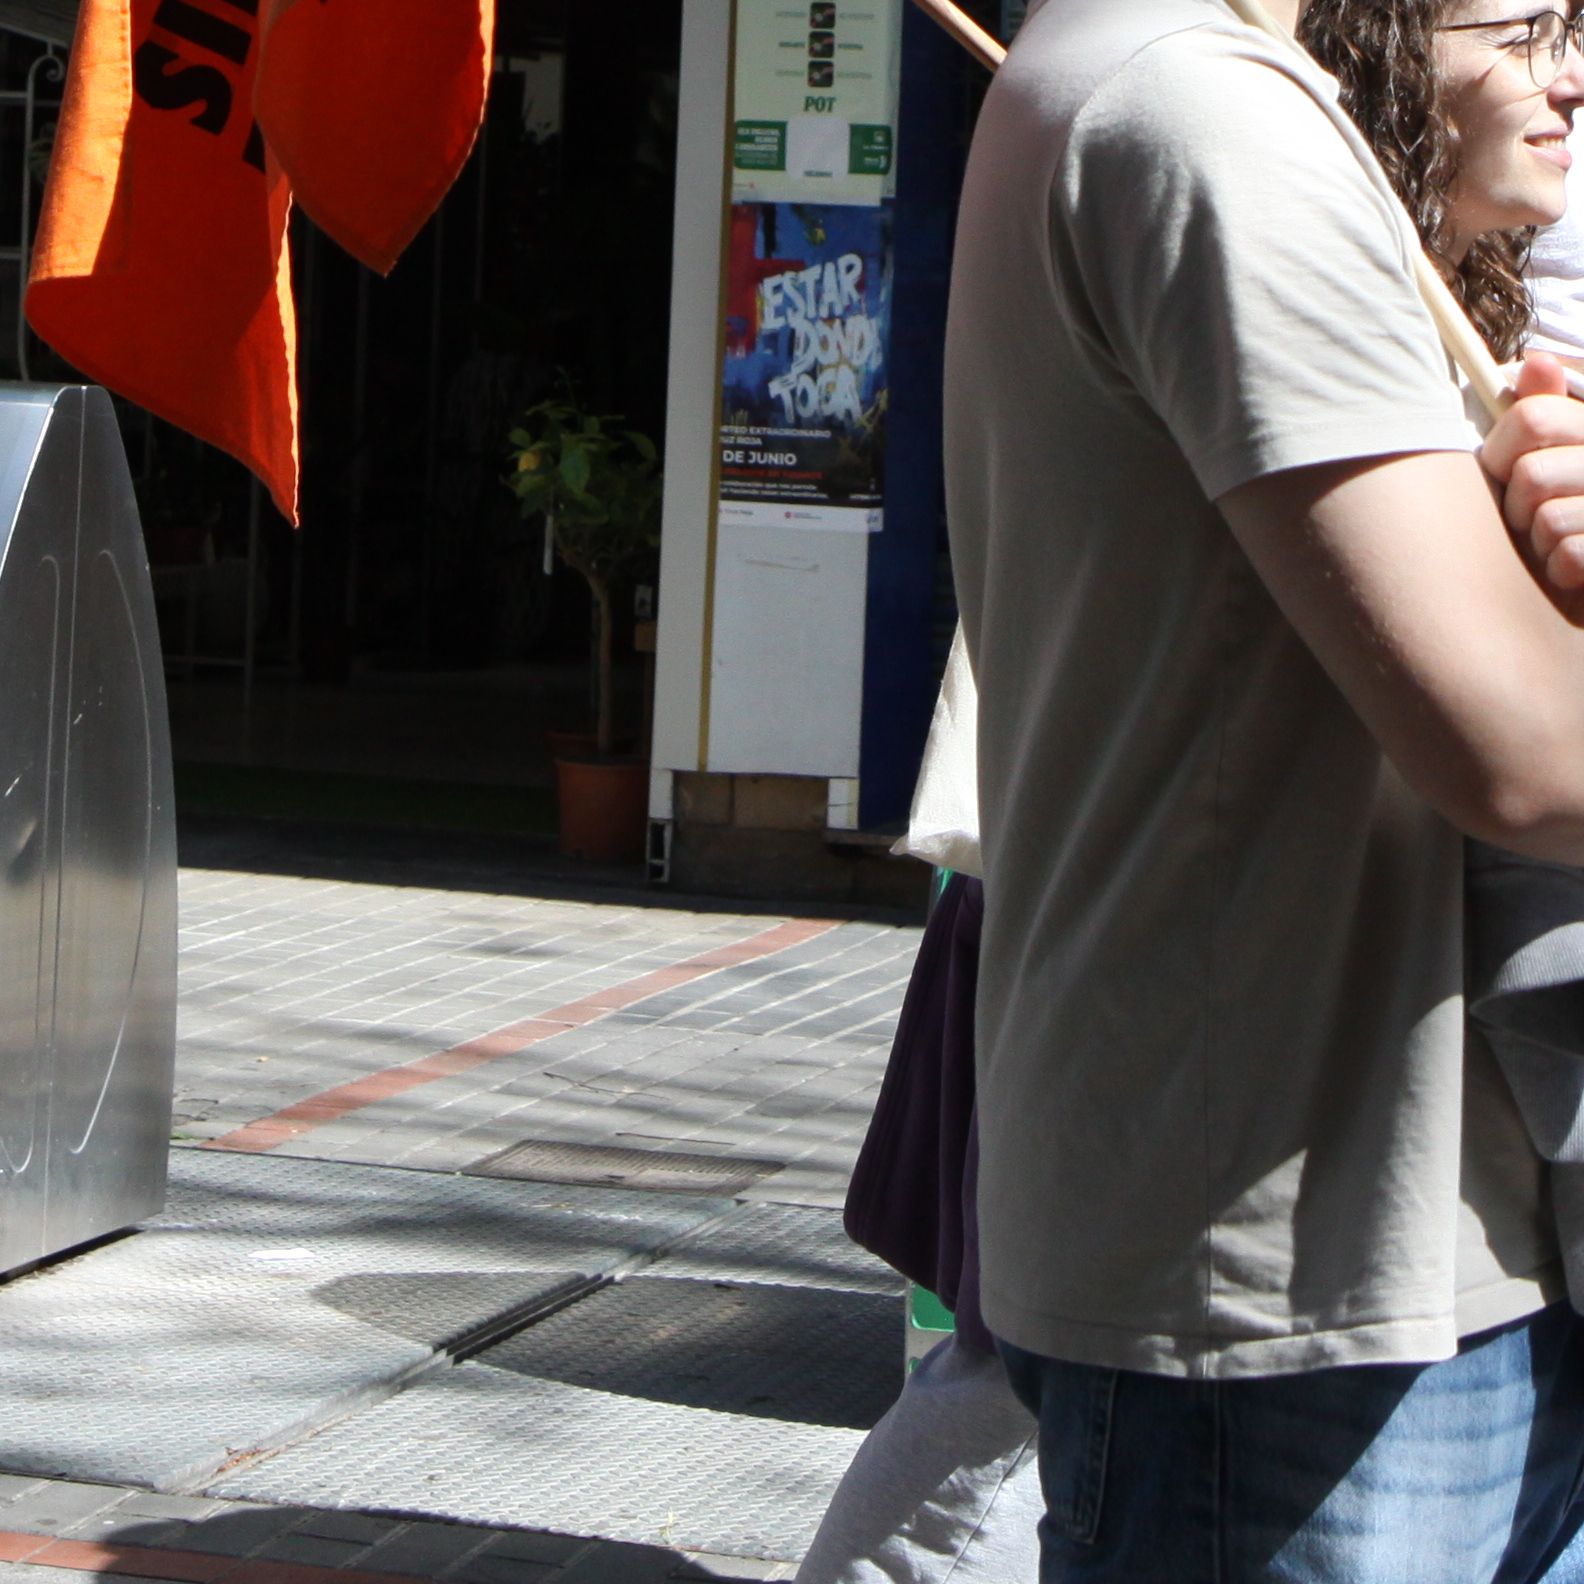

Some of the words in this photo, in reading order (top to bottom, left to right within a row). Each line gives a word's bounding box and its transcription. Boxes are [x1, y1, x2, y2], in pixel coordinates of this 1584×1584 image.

[803, 96, 837, 113] POT
[760, 252, 864, 330] ESTAR
[768, 364, 864, 424] TOCA
[749, 425, 832, 440] EXTRAORDINARIO
[722, 449, 746, 464] DE
[747, 450, 798, 466] JUNIO
